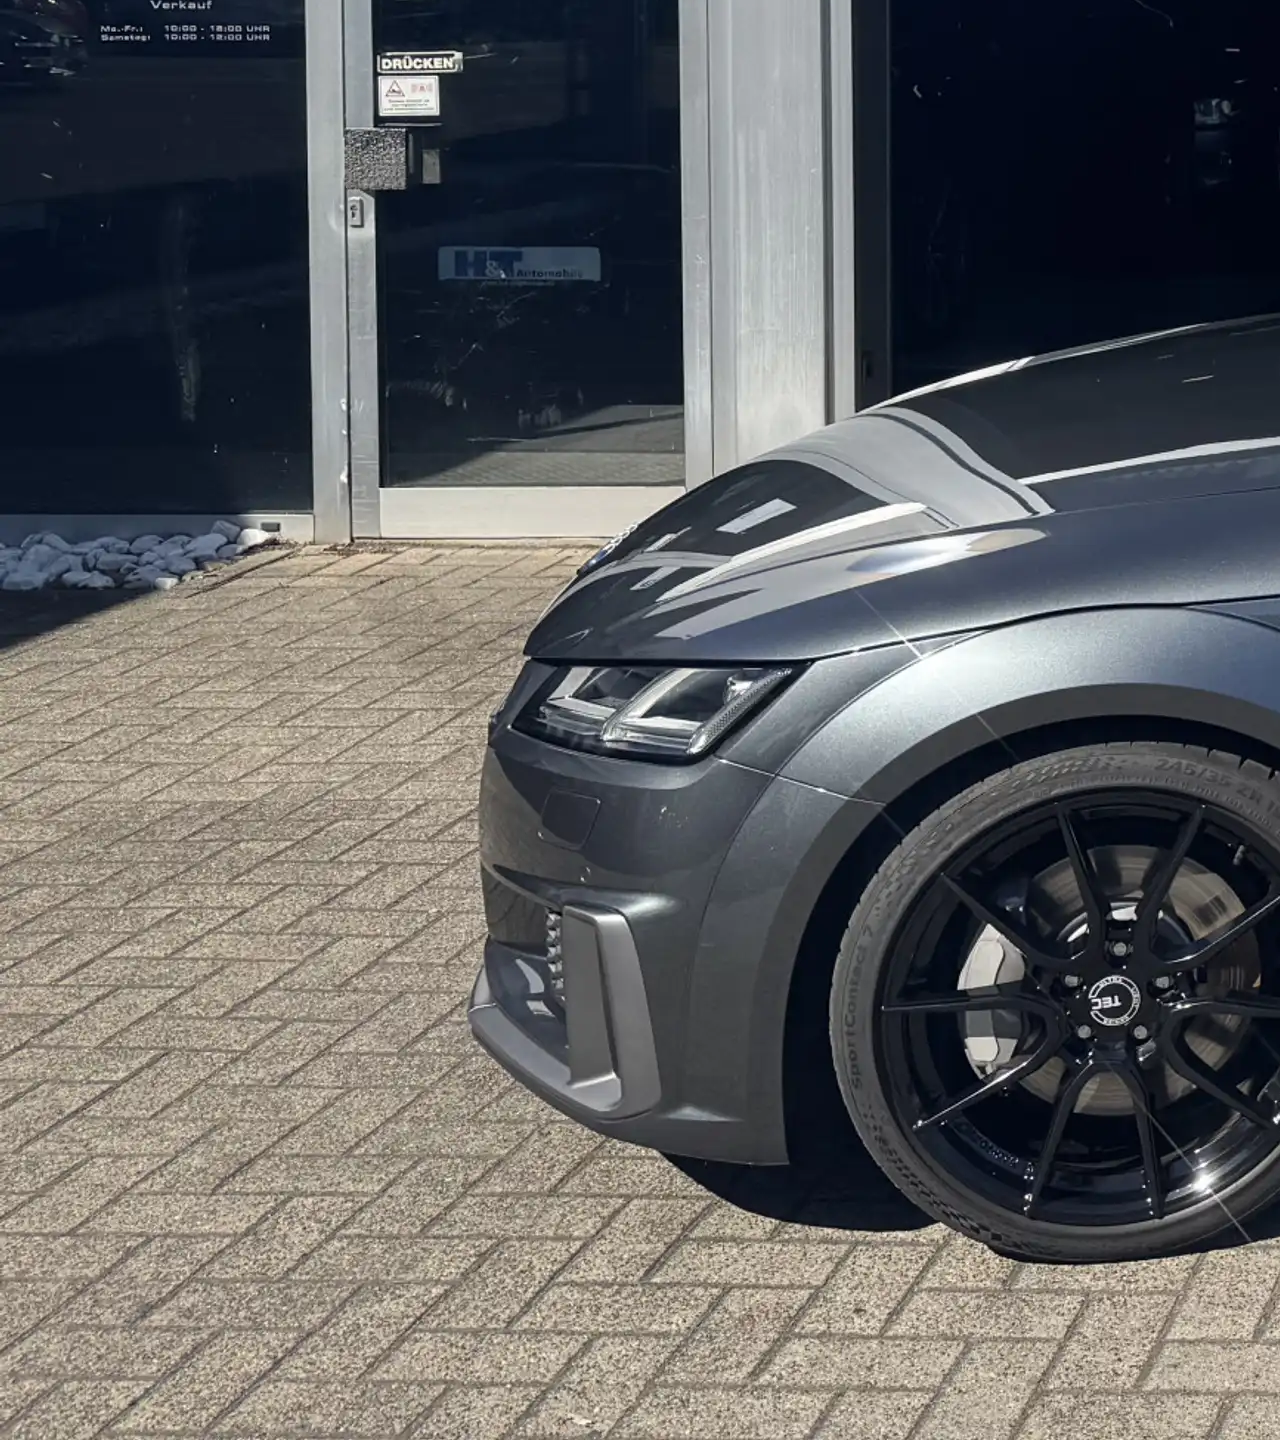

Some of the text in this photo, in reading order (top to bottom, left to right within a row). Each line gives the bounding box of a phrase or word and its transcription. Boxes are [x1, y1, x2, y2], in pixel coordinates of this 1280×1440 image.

[150, 0, 212, 10] Verkauf
[246, 25, 271, 33] UHR
[381, 56, 454, 70] DRÜCKEN
[1091, 994, 1122, 1010] TEC
